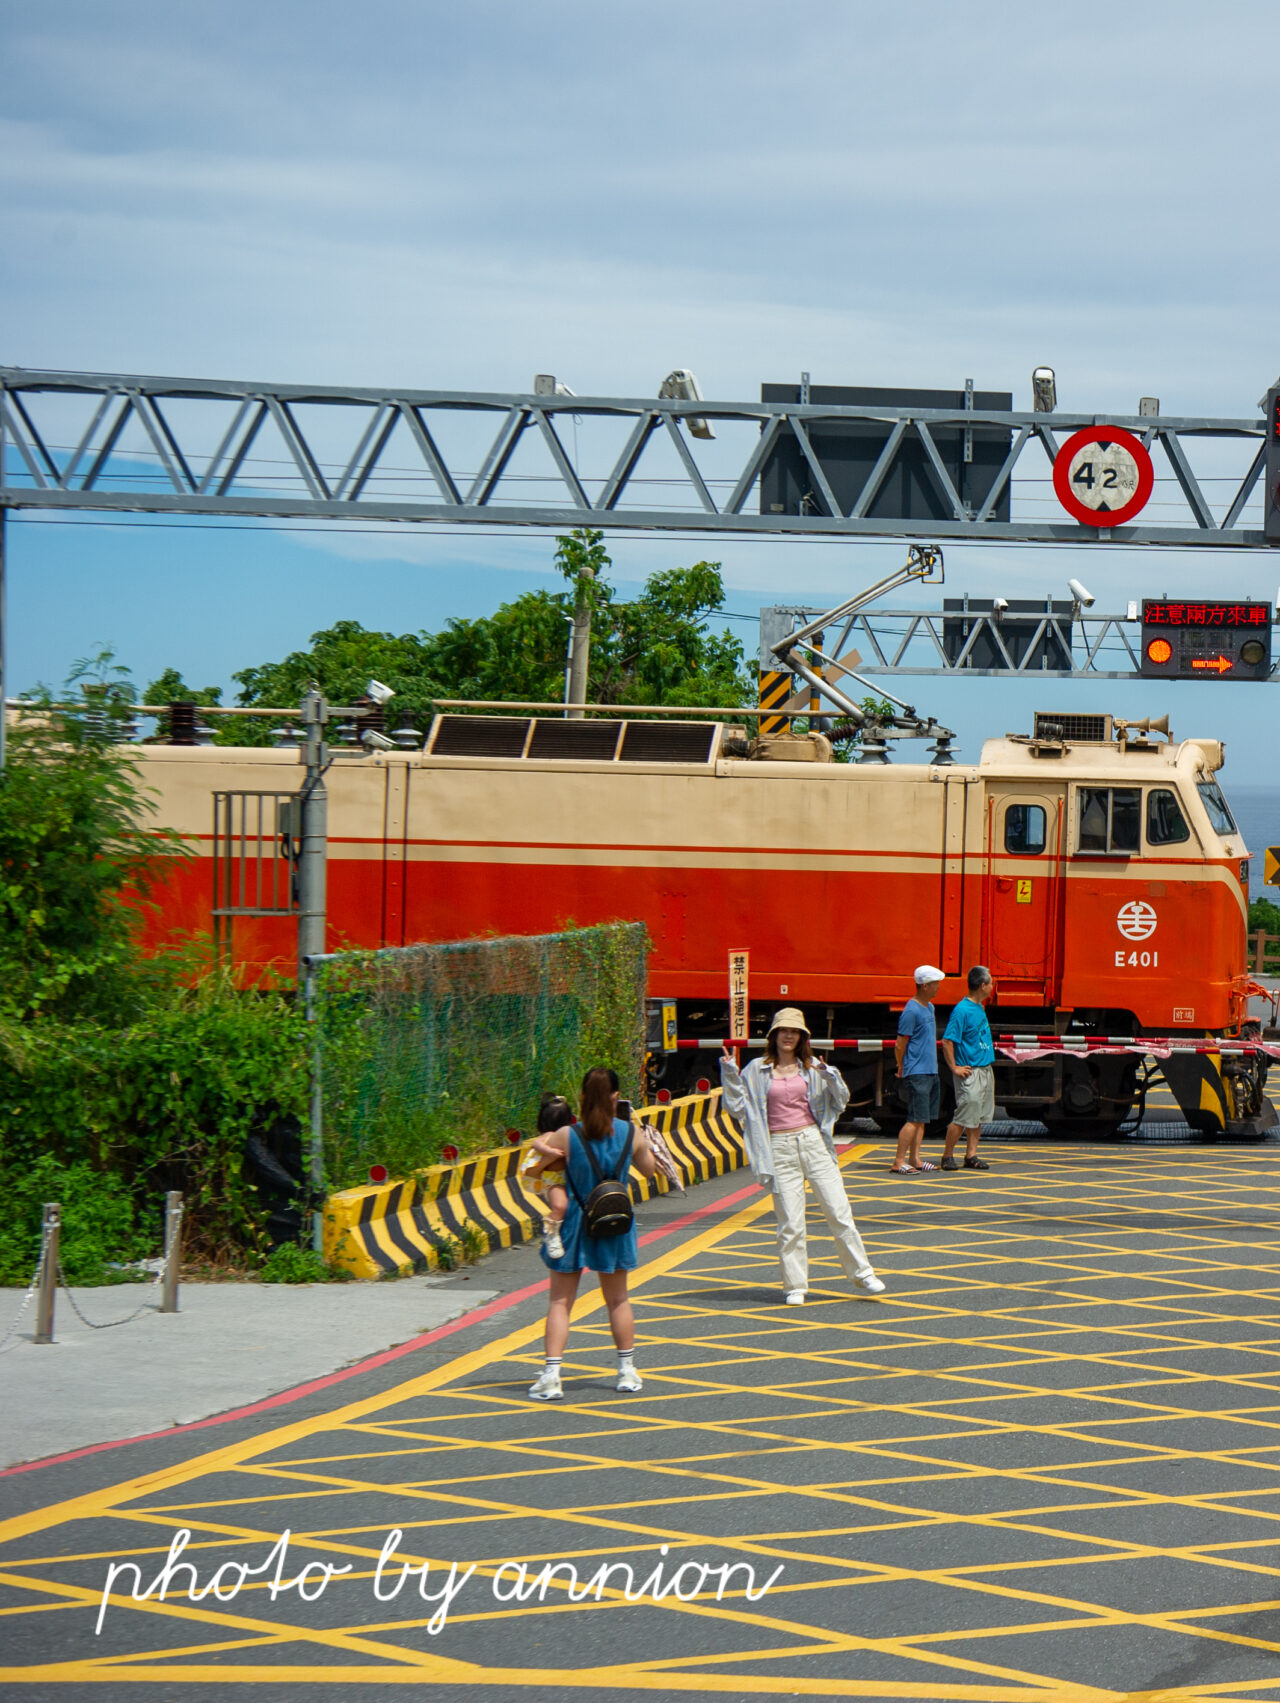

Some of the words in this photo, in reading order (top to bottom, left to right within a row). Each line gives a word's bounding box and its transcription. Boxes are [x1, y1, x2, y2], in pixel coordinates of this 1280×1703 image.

[1144, 603, 1268, 626] 注意兩方來車
[1115, 951, 1158, 967] E401
[734, 956, 745, 1037] 禁止通行
